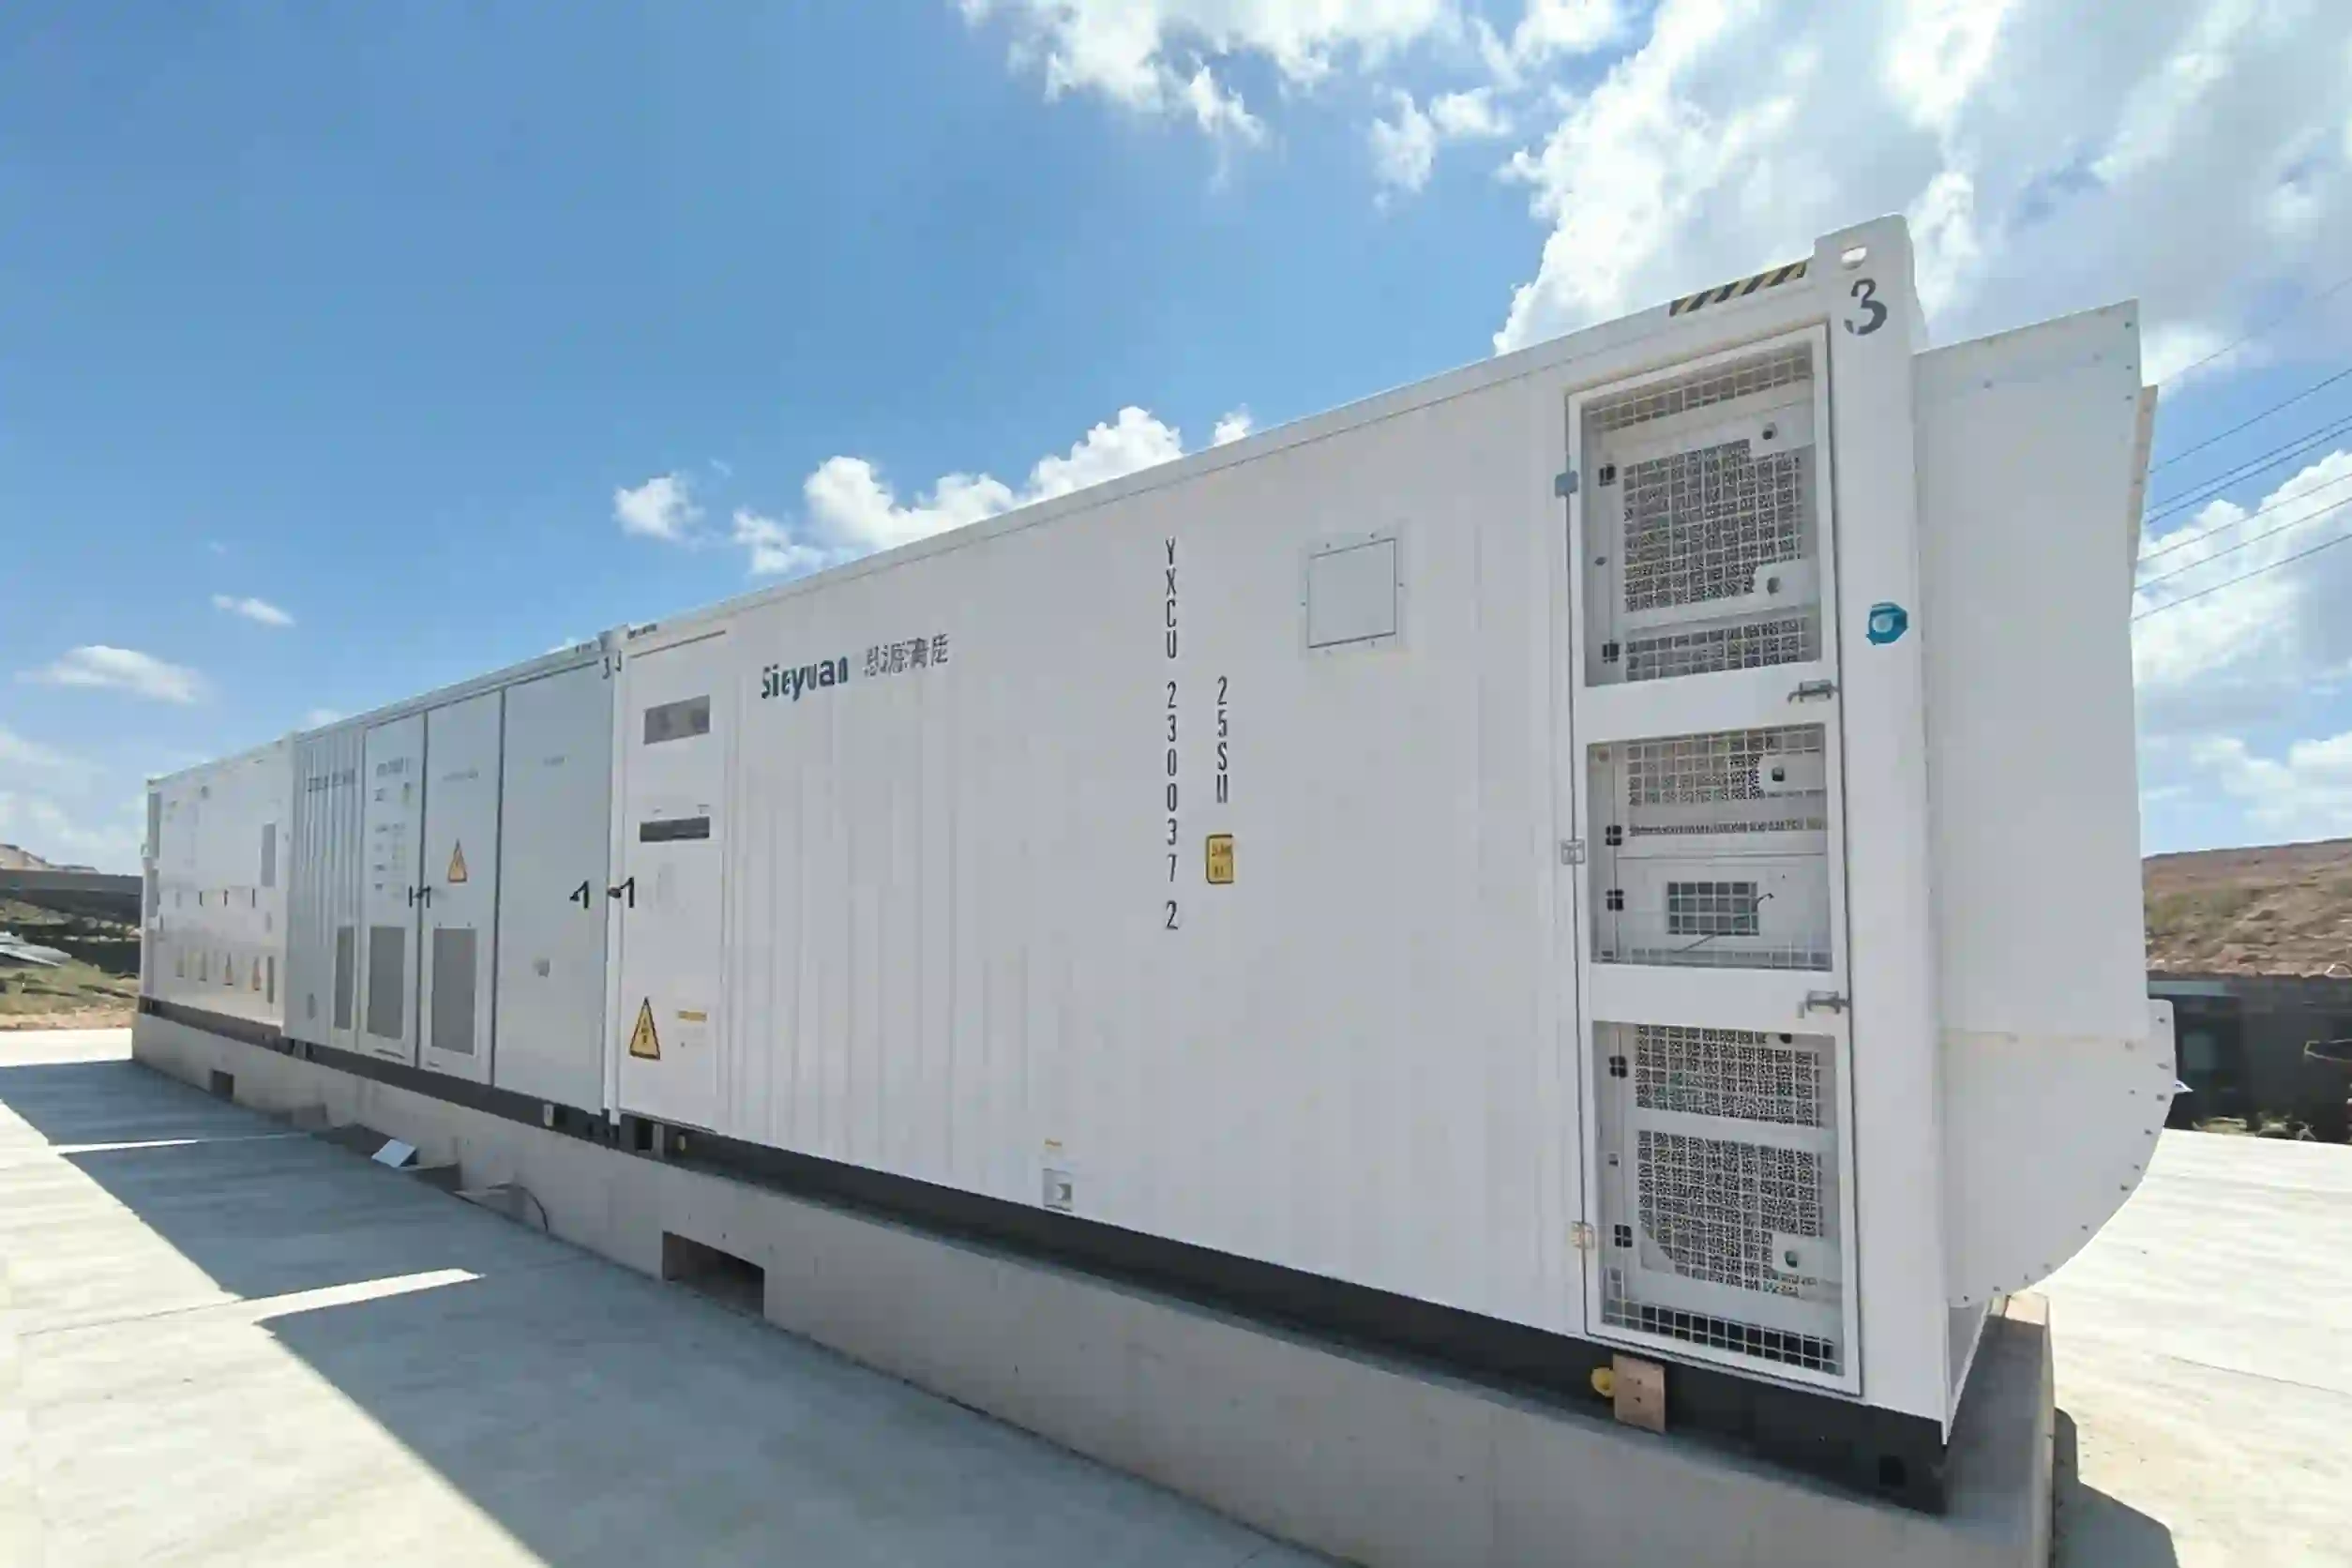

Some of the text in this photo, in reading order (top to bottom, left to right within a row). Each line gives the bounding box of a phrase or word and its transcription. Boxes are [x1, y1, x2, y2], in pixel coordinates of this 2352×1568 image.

[1844, 278, 1888, 336] 3
[761, 656, 849, 701] Sieyuan
[1164, 536, 1180, 931] YXCU 230037 2
